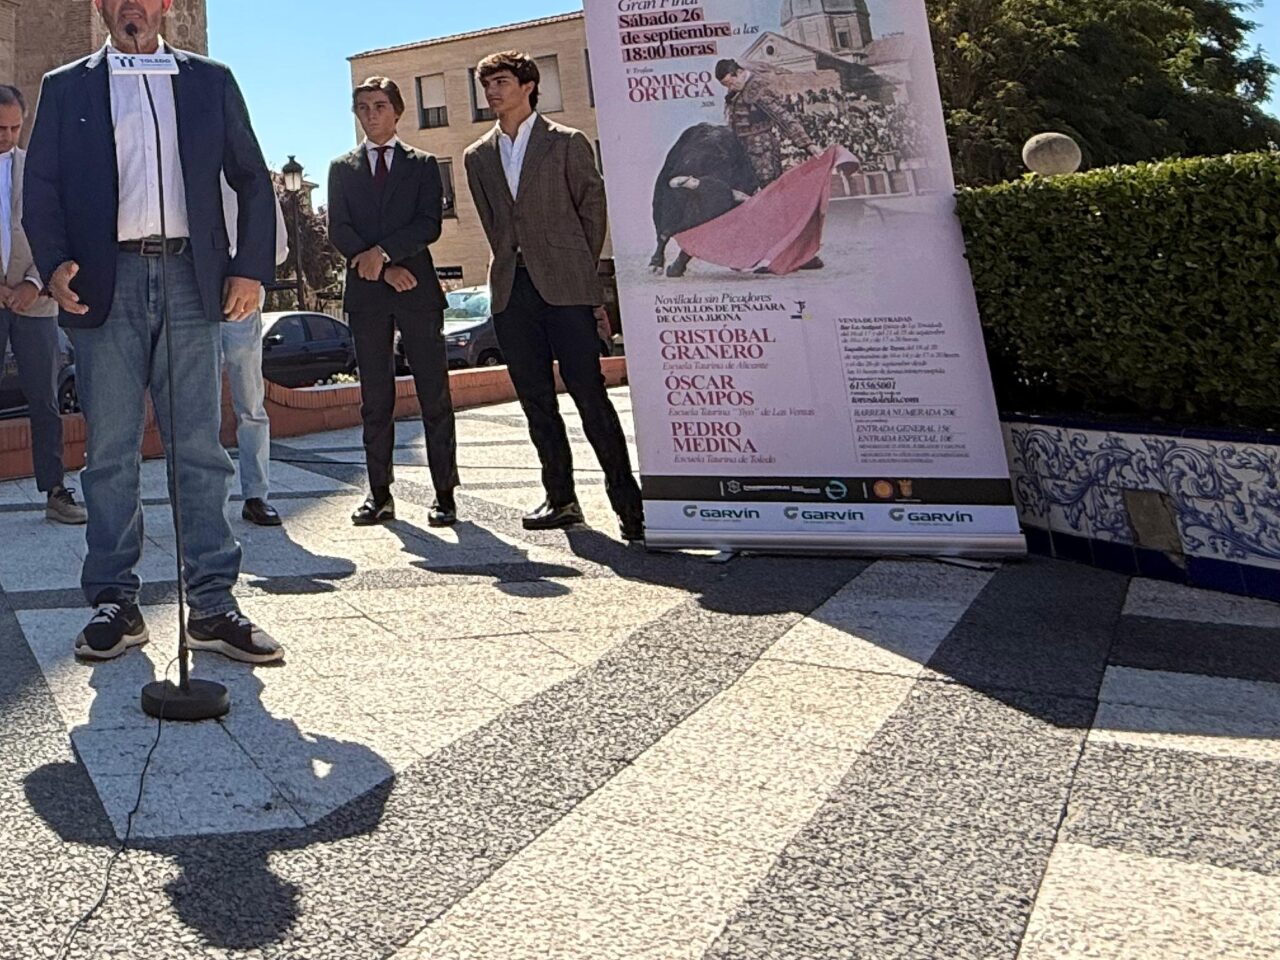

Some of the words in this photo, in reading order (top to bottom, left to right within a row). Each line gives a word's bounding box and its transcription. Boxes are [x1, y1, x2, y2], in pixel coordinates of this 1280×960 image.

[619, 12, 678, 28] Sábado
[681, 9, 701, 22] 26
[621, 31, 640, 44] de
[641, 24, 731, 46] septiembre
[743, 23, 759, 34] las
[624, 44, 666, 61] 18:00
[669, 43, 715, 58] horas
[627, 71, 712, 89] DOMINGO
[628, 83, 714, 102] ORTEGA
[654, 294, 702, 306] Novillada
[704, 295, 719, 304] sin
[721, 292, 772, 304] Picadores
[655, 306, 661, 314] 6
[662, 305, 714, 313] NOVILLOS
[716, 305, 729, 313] DE
[731, 302, 786, 312] PEÑAJARA
[657, 315, 671, 323] DE
[672, 314, 704, 323] CASTA
[659, 325, 776, 345] CRISTÓBAL
[661, 344, 764, 360] GRANERO
[662, 362, 692, 371] Escuela
[694, 361, 723, 370] Taurina
[725, 361, 735, 370] de
[736, 361, 769, 369] Alicante
[665, 372, 736, 390] ÓSCAR
[667, 391, 755, 406] CAMPOS
[851, 394, 919, 403] torostoledo.com
[668, 408, 699, 416] Escuela
[701, 408, 730, 416] Taurina
[760, 407, 771, 415] de
[772, 407, 786, 416] Las
[854, 408, 891, 416] BARRERA
[892, 408, 941, 416] NUMERADA
[671, 421, 741, 437] PEDRO
[856, 424, 894, 432] ENTRADA
[896, 424, 935, 432] GENERAL
[673, 437, 758, 453] MEDINA
[674, 455, 705, 463] Escuela
[707, 455, 736, 463] Taurina
[738, 455, 748, 463] de
[750, 454, 776, 463] Toledo
